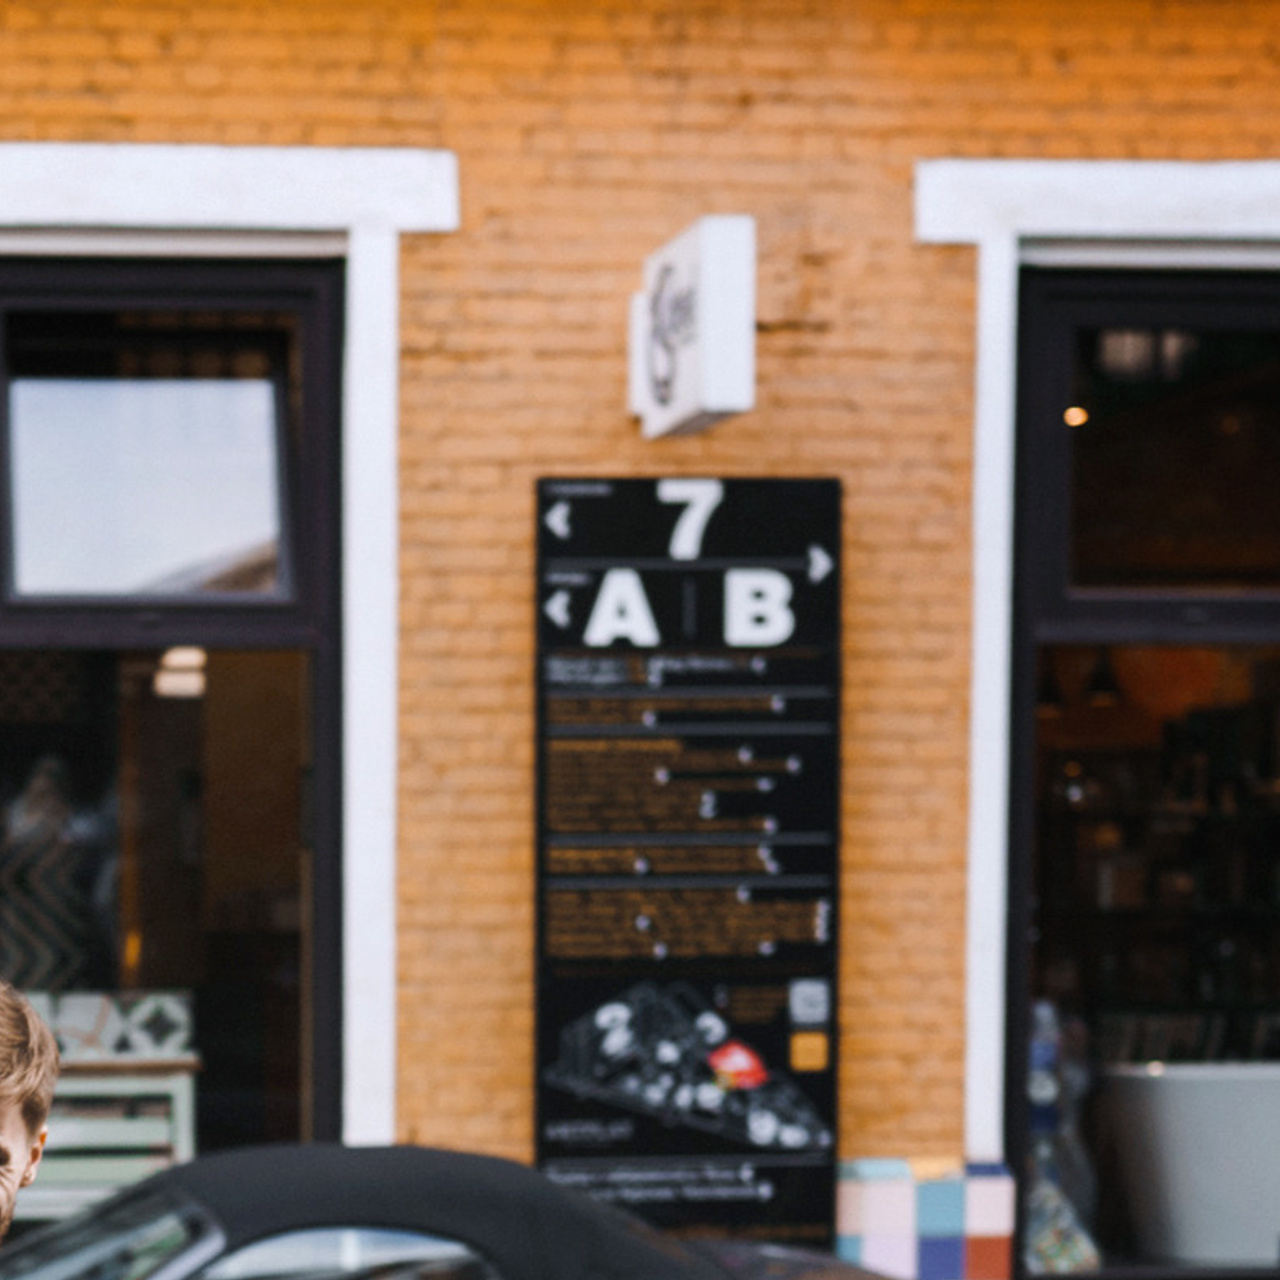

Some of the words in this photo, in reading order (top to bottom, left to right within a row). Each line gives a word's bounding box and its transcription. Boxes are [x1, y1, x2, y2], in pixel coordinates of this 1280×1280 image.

[657, 479, 723, 560] 7
[583, 567, 661, 647] A
[724, 567, 796, 647] B
